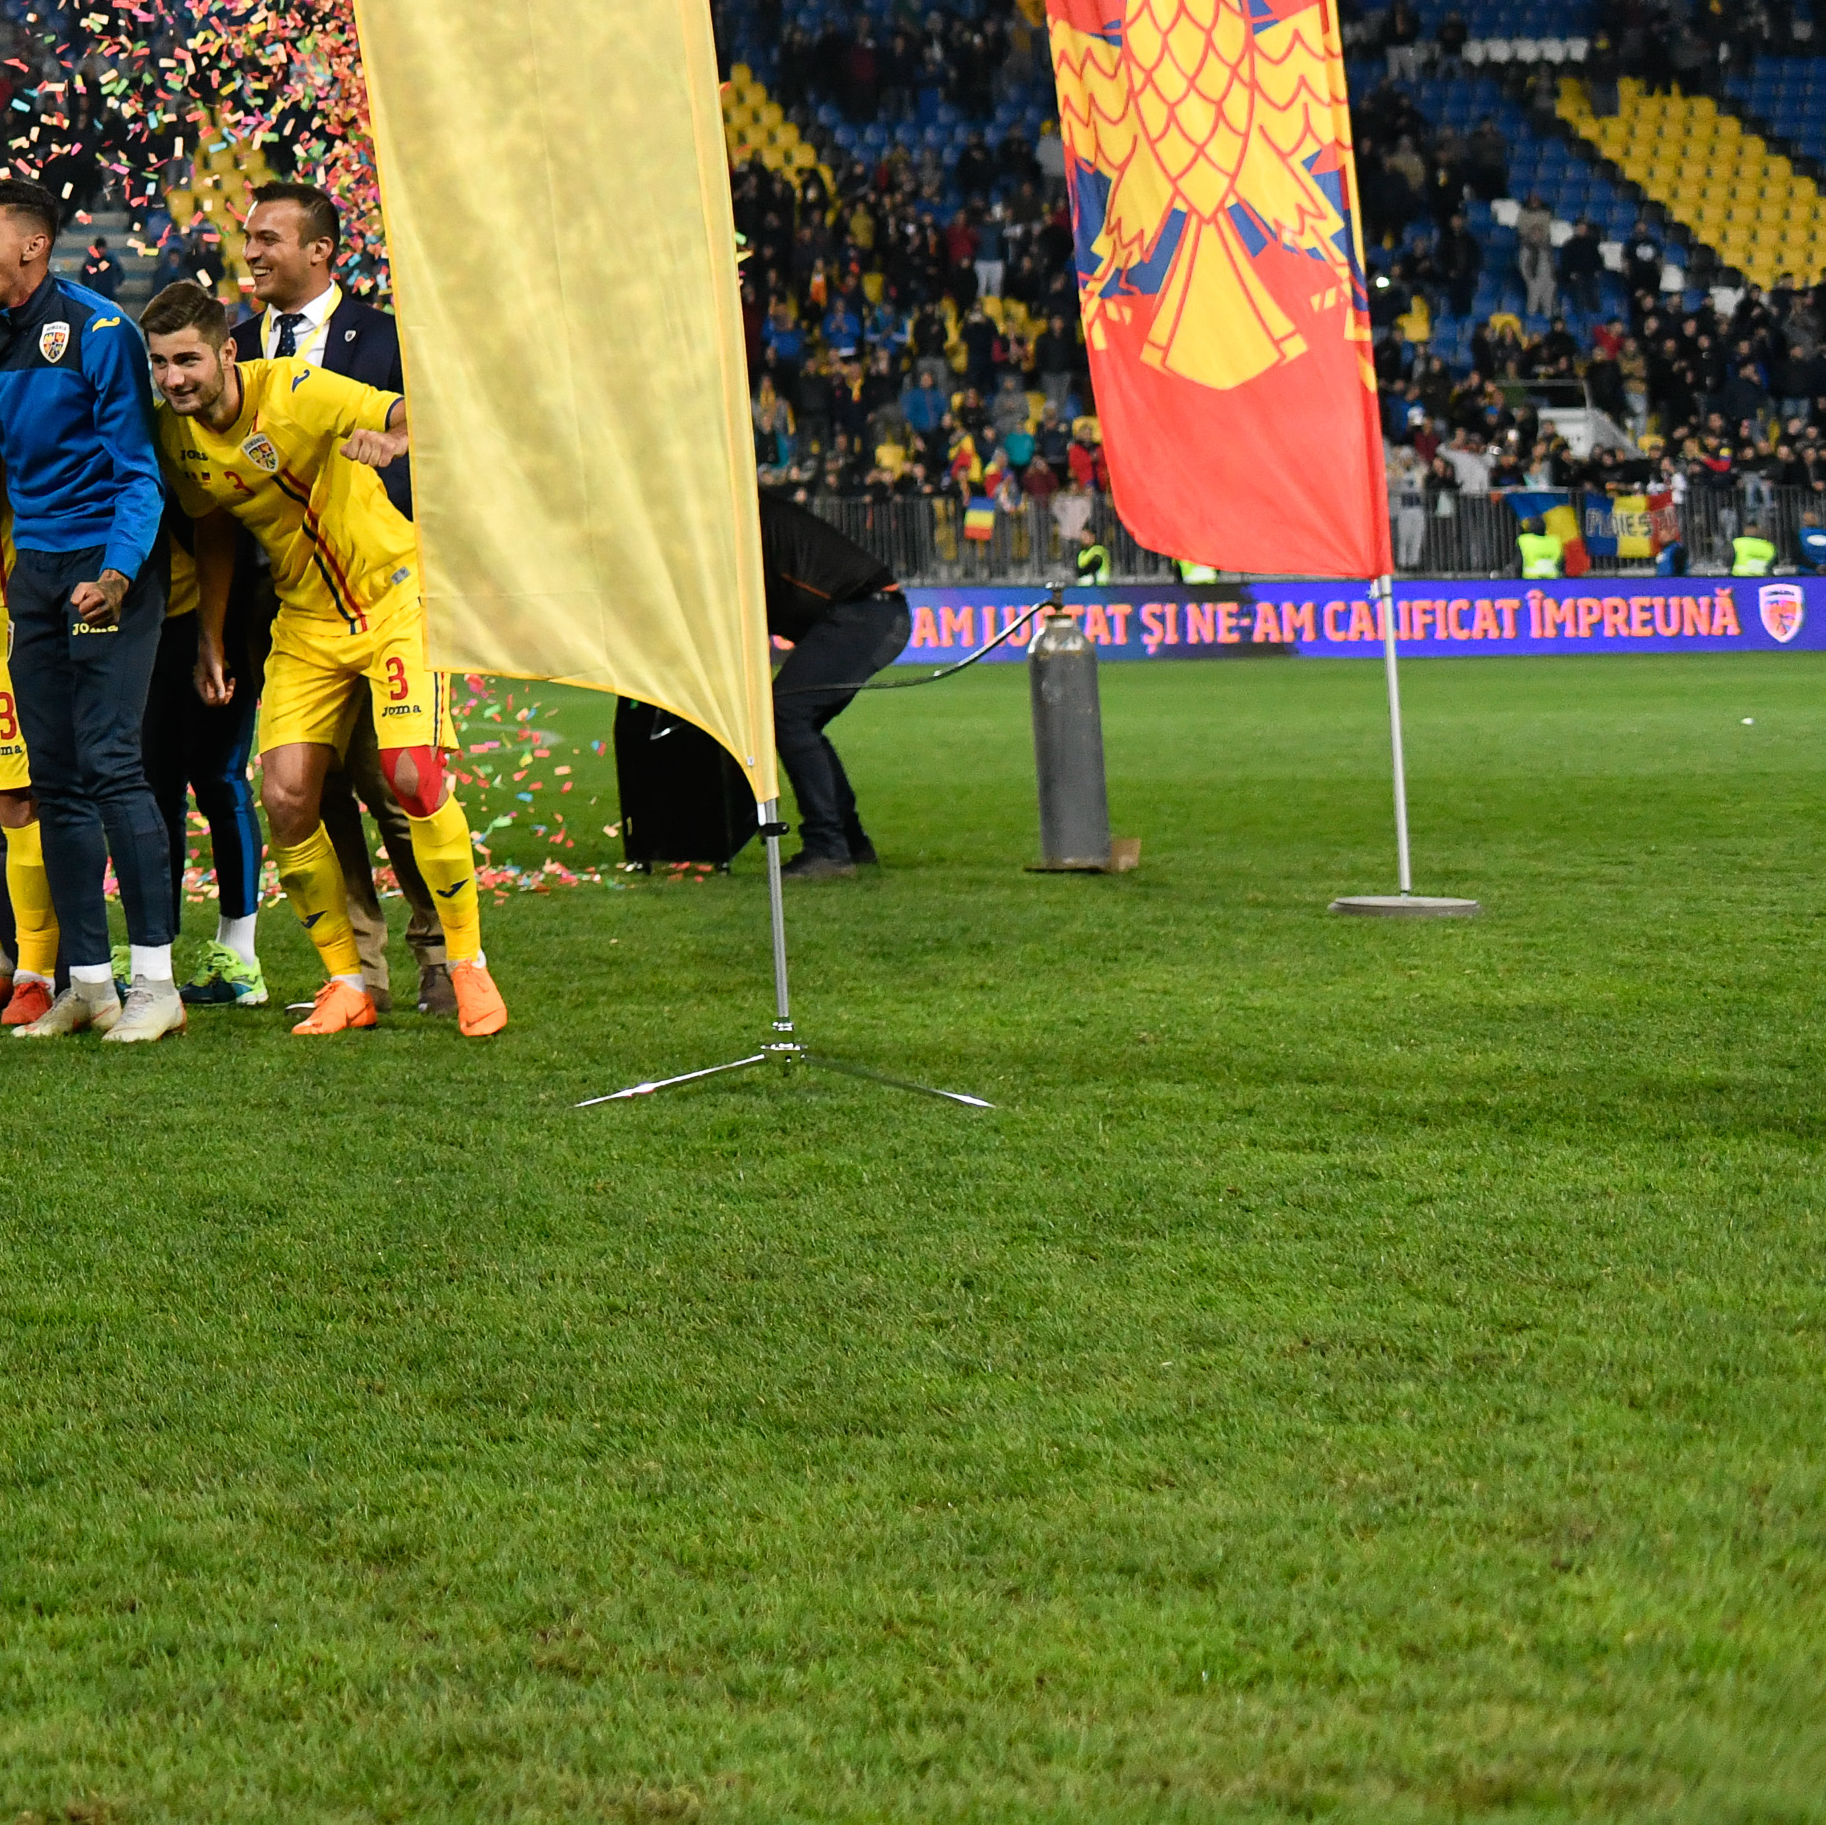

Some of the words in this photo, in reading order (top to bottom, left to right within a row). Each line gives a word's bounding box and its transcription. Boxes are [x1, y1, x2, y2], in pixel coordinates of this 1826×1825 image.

[911, 606, 974, 648] AM
[1186, 602, 1314, 645] NE-AM
[1525, 588, 1741, 639] ÎMPREUNĂ
[385, 656, 409, 701] 3
